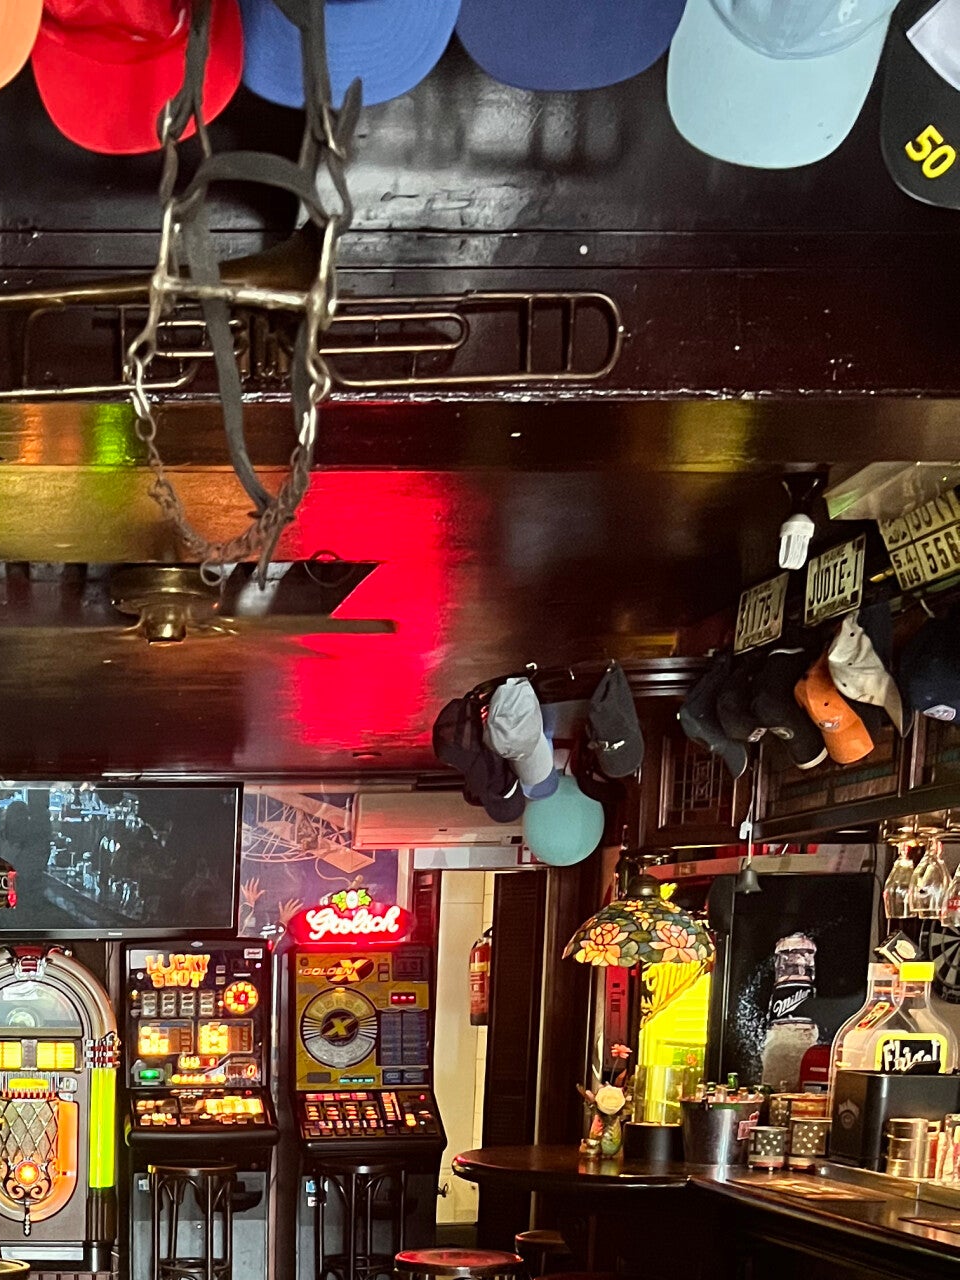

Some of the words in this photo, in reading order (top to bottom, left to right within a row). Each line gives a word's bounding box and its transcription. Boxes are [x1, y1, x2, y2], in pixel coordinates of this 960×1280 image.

[904, 124, 957, 179] 50
[305, 905, 401, 941] Grolsch
[145, 953, 211, 975] LUCKY
[302, 967, 354, 978] GOLDEN
[328, 958, 370, 983] X
[151, 970, 205, 989] SHOT
[772, 986, 812, 1018] Miller
